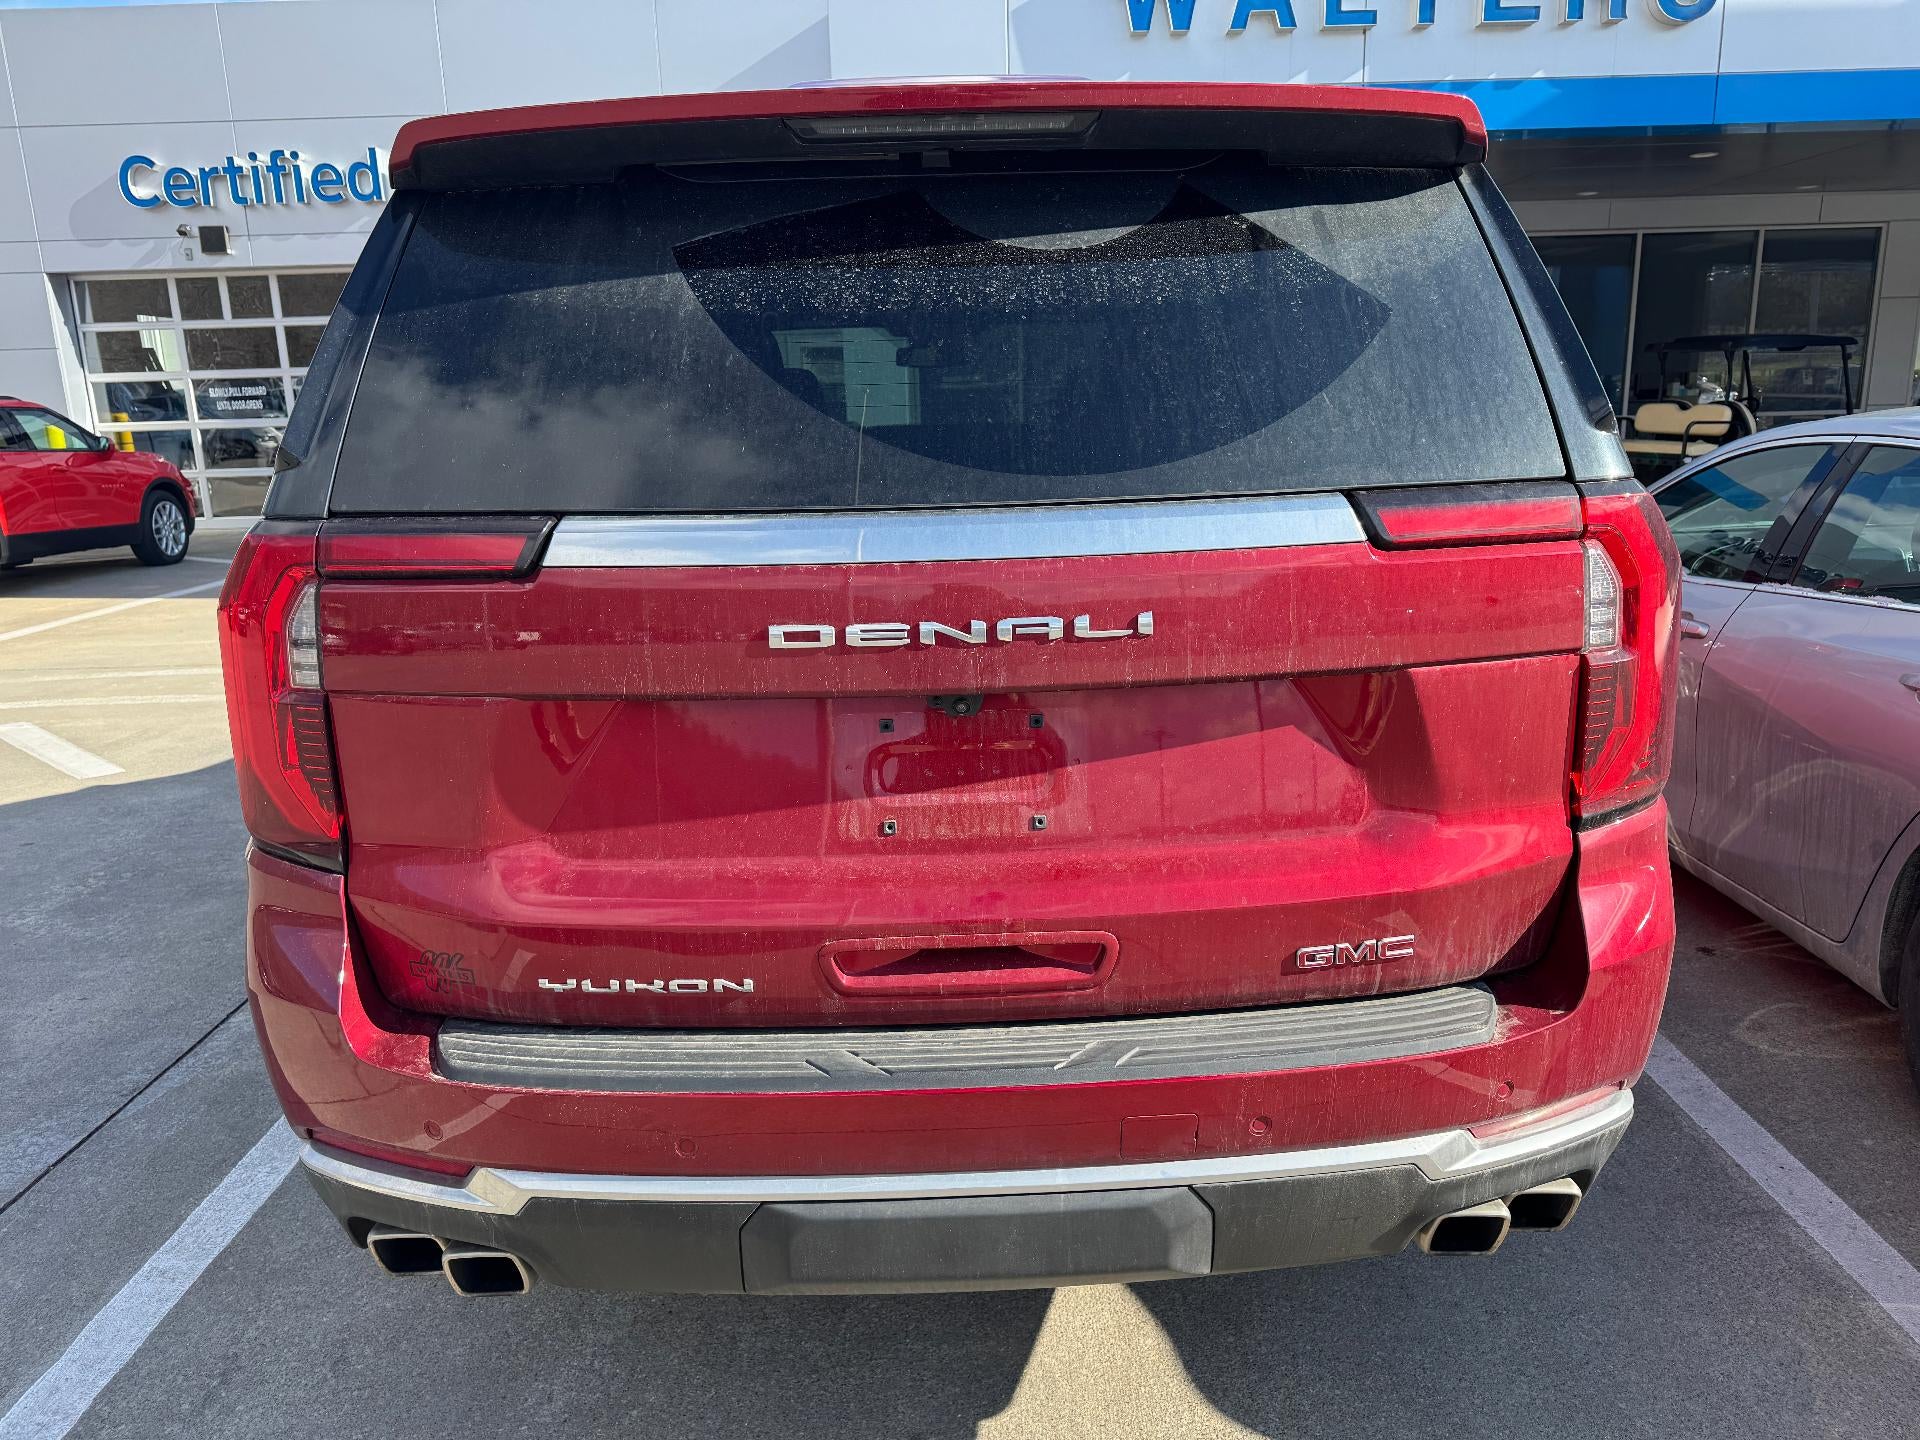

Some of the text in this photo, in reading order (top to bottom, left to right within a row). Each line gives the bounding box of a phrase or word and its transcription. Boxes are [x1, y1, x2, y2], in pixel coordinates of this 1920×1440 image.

[118, 147, 384, 208] Certified
[768, 610, 1153, 649] DENALI
[1297, 934, 1415, 969] GMC
[538, 978, 754, 993] YUKON
